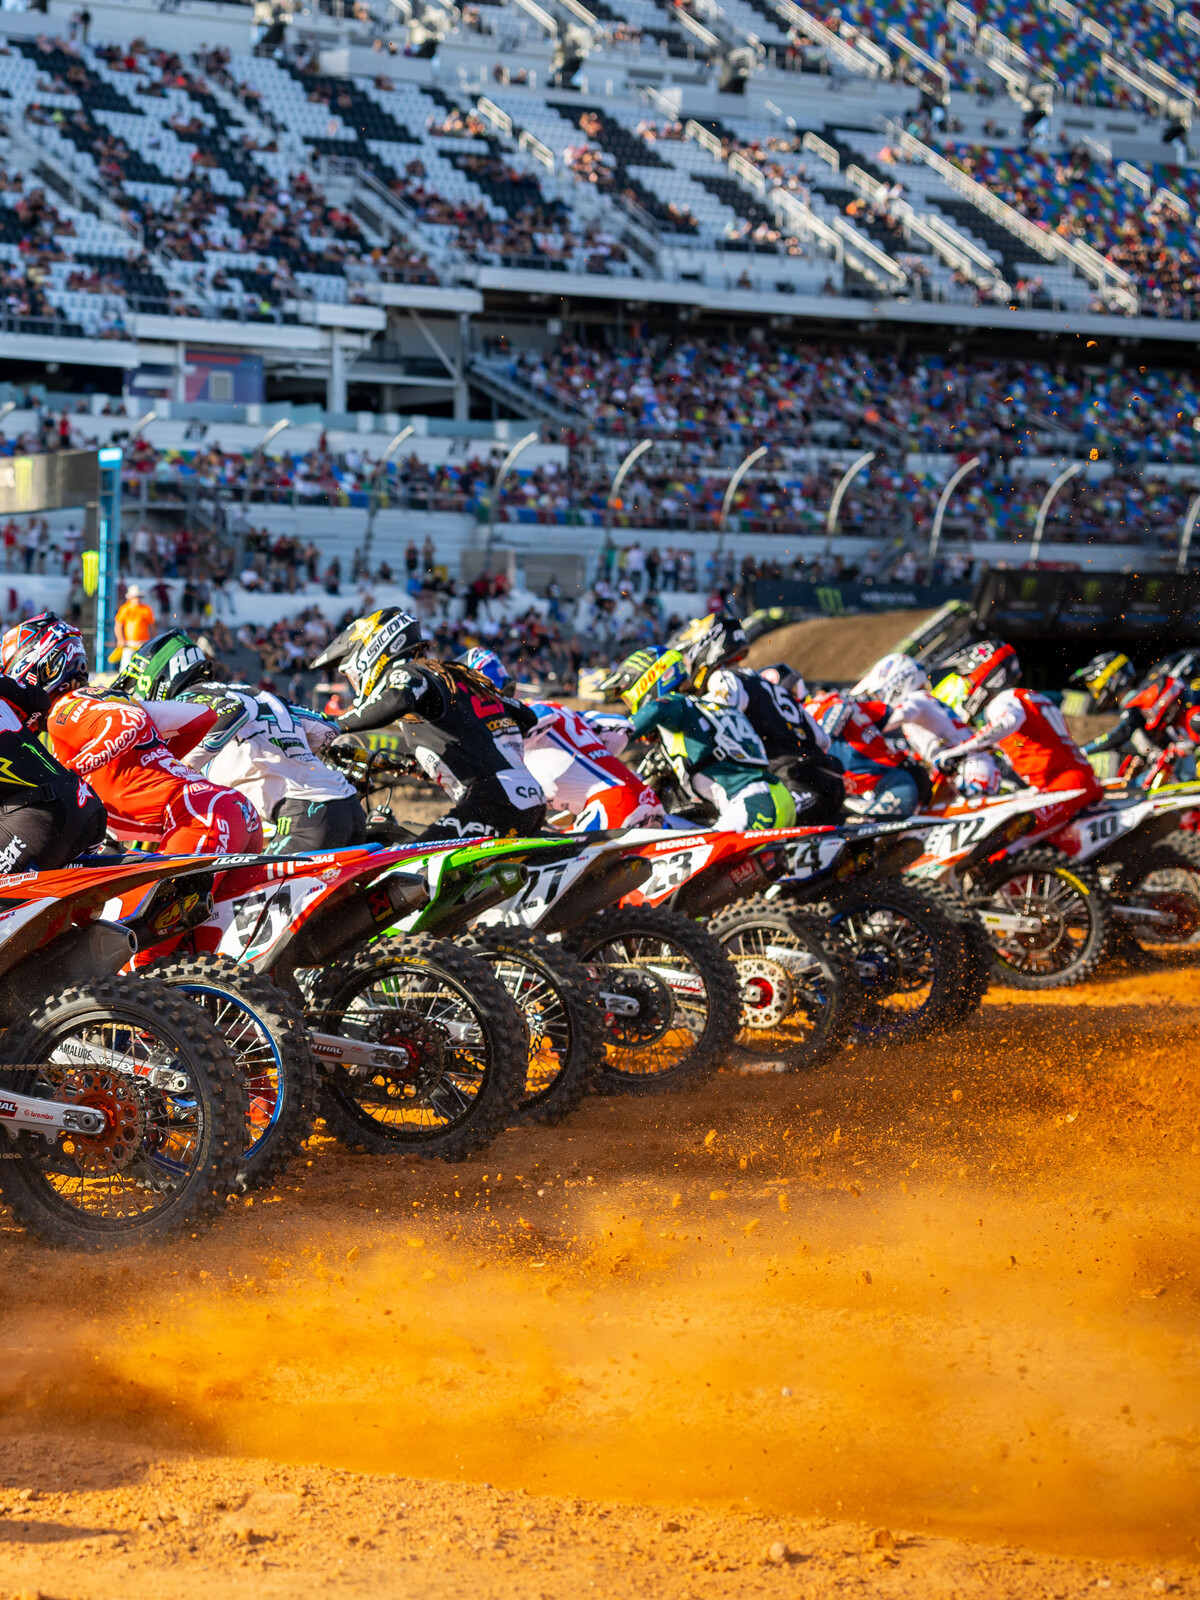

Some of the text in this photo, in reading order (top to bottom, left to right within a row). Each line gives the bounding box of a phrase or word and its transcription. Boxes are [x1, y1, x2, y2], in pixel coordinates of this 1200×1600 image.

[76, 727, 137, 774] Troy Lee
[1087, 815, 1118, 843] 10
[656, 836, 707, 851] HONDA
[646, 851, 693, 897] 23
[30, 1110, 54, 1121] brembo
